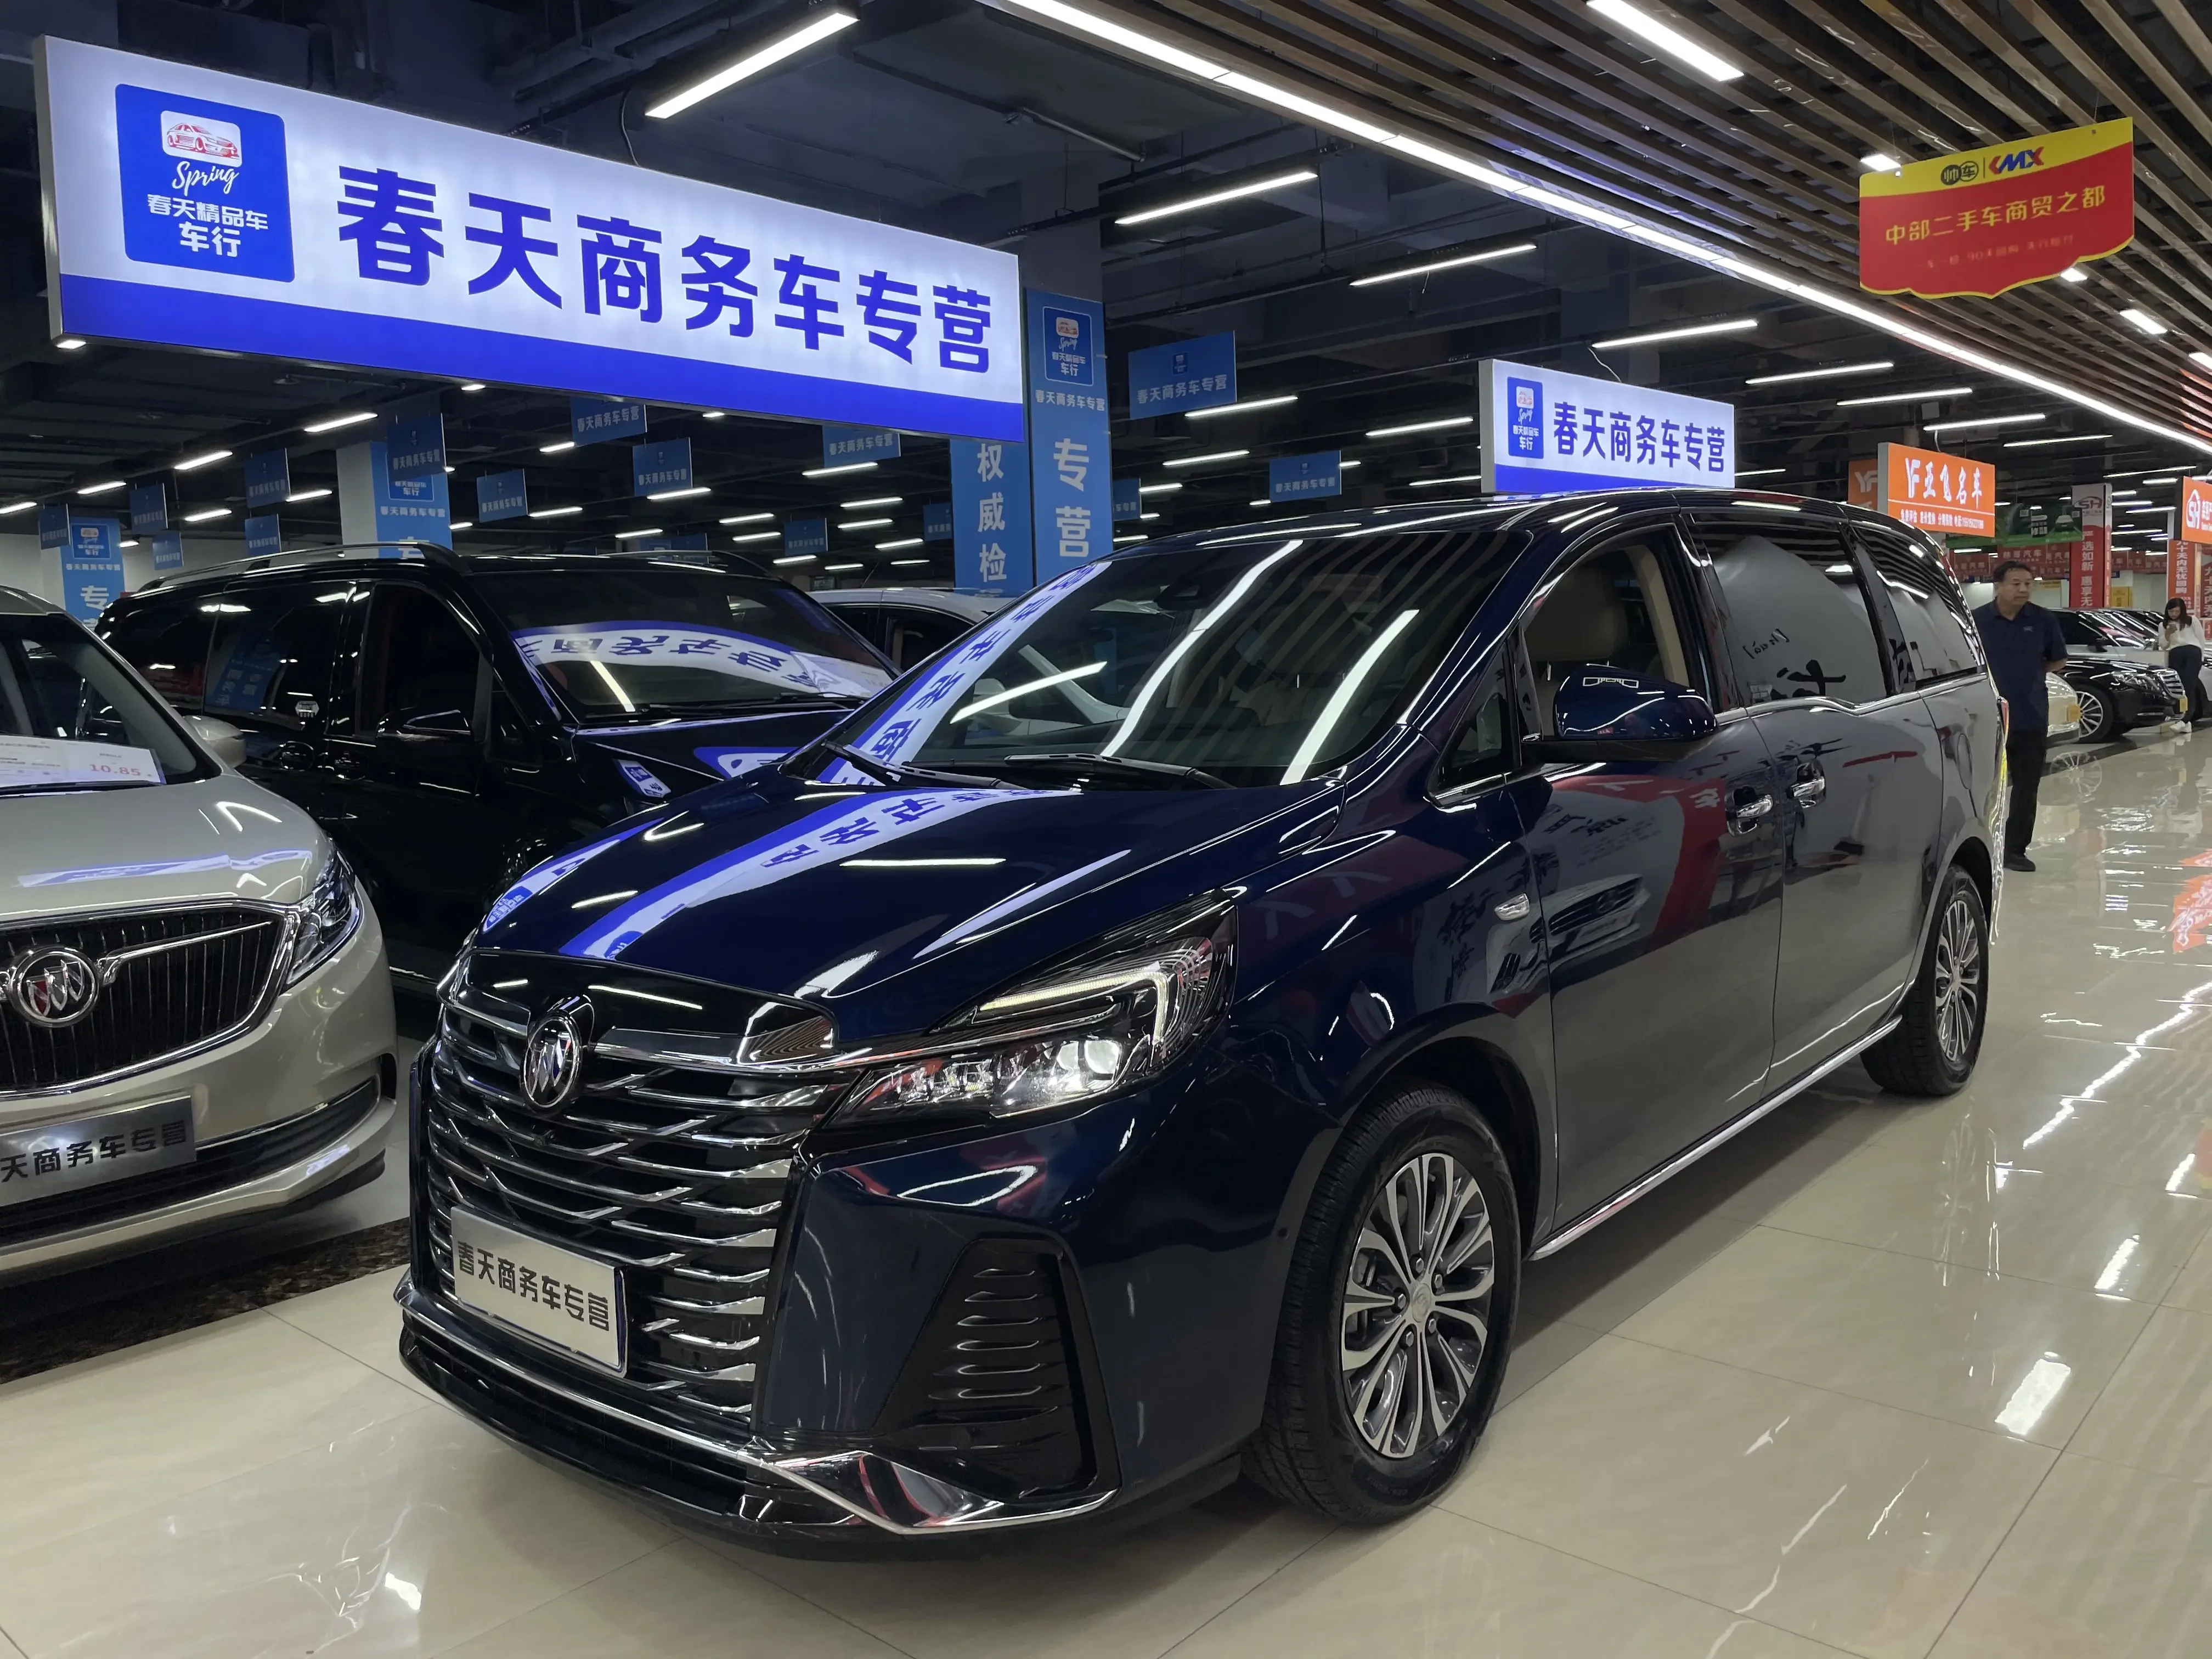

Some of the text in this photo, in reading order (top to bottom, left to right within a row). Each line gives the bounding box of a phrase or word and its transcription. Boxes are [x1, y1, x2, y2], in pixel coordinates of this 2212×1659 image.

[172, 161, 239, 196] Spring
[147, 194, 268, 231] 春天精品车
[1886, 185, 2106, 245] 中部二手车商贸之都
[179, 222, 241, 258] 车行
[338, 165, 991, 374] 春天商务车专营
[1060, 363, 1079, 376] 车行
[1035, 389, 1105, 411] 春天商务车专营
[1136, 374, 1227, 405] 春天商务车专营
[577, 404, 640, 433] 春天商务车专营
[1519, 436, 1533, 450] 车行
[1554, 401, 1725, 473] 春天商务车专营
[1053, 438, 1091, 558] 专营
[89, 764, 142, 776] 10.85
[458, 1242, 610, 1332] 春天商务车专营
